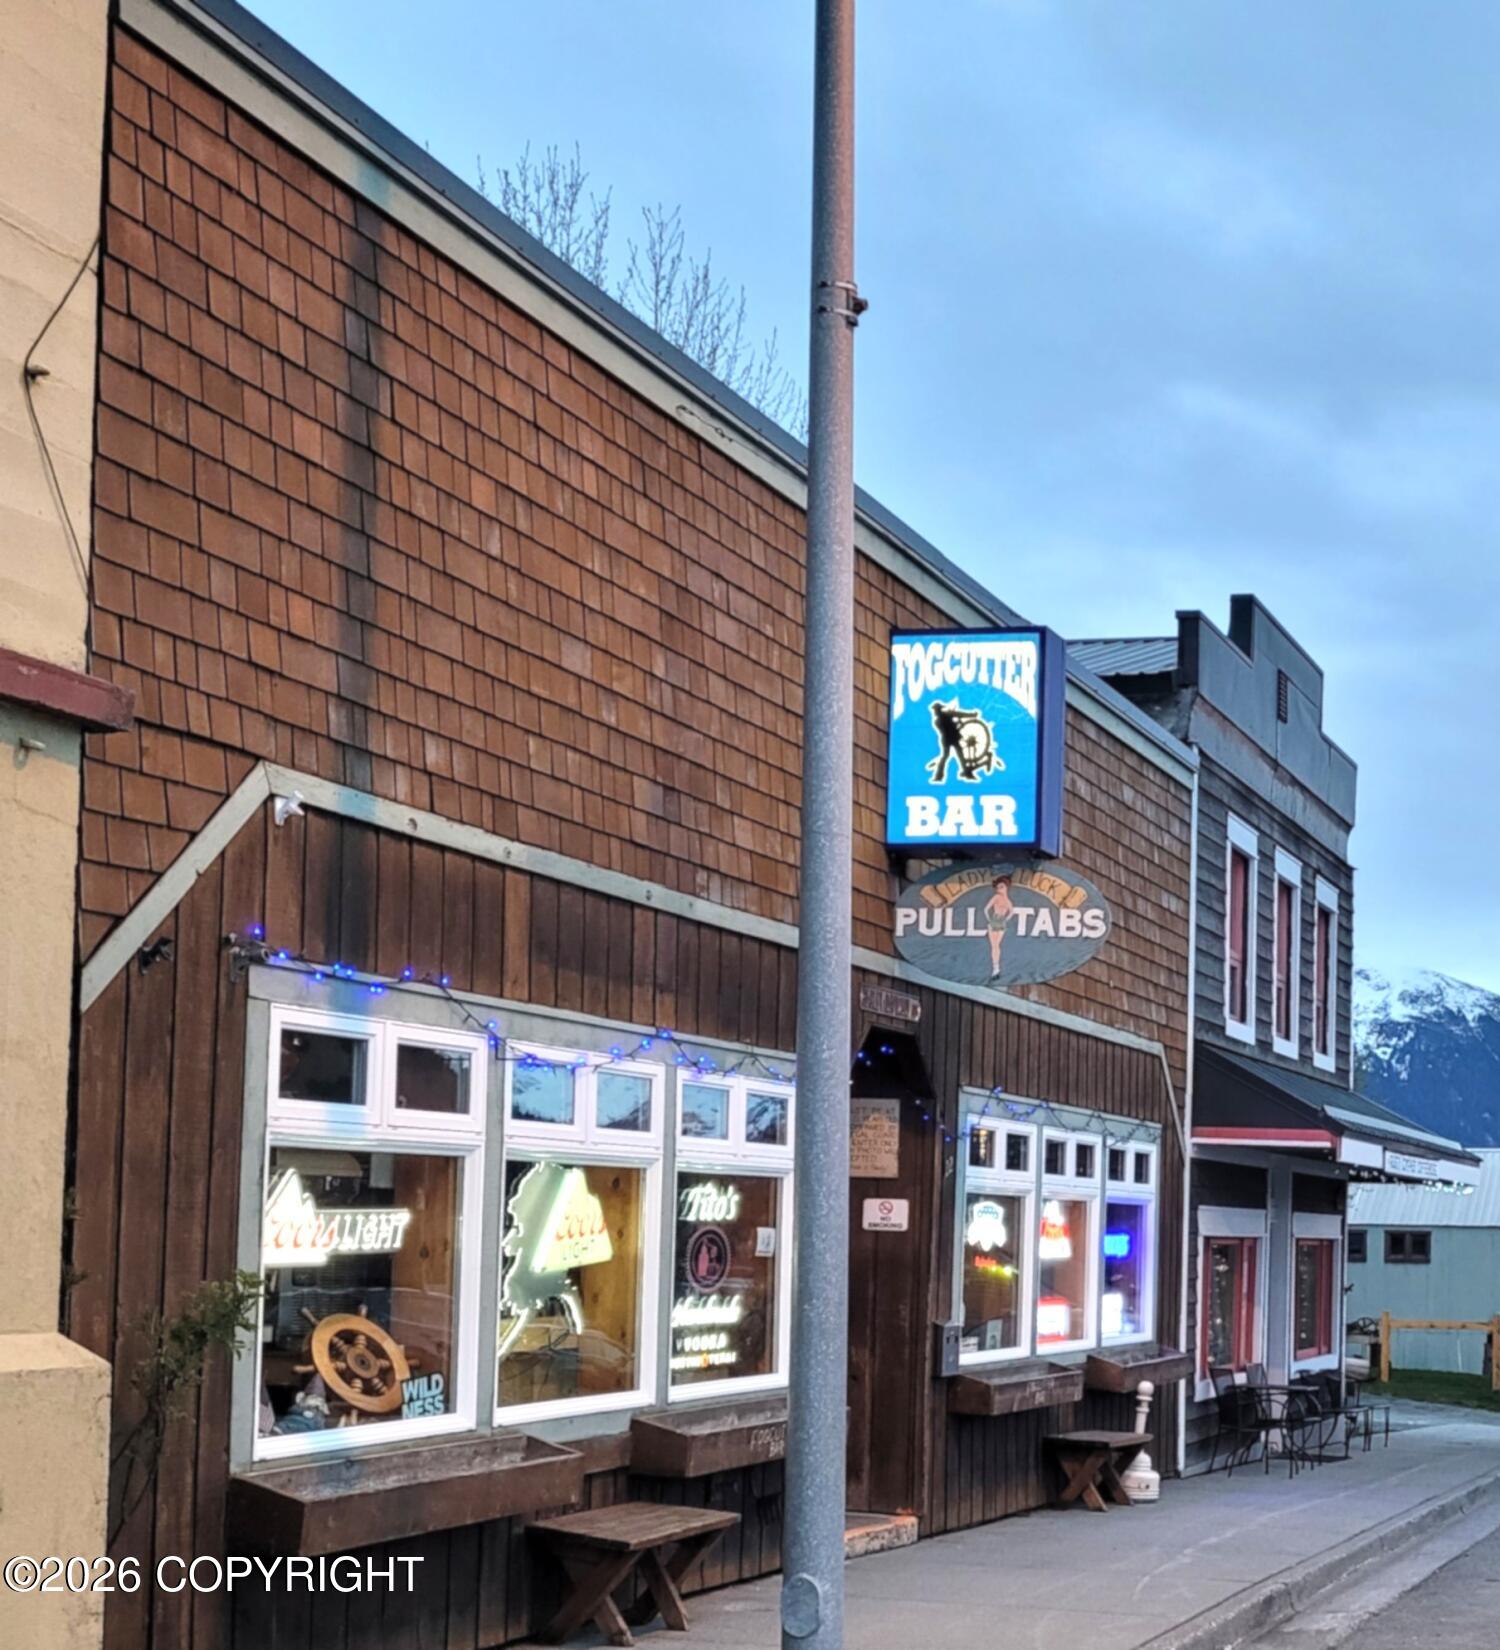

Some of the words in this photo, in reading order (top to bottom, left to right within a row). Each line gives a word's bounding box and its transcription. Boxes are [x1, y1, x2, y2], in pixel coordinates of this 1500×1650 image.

[891, 640, 1037, 720] FOGCUTTER
[905, 795, 1017, 837] BAR
[944, 868, 989, 896] LADY
[1019, 869, 1062, 899] LUCK
[895, 907, 987, 938] PULL
[1012, 907, 1107, 938] TABS
[679, 1182, 740, 1221] Tito's
[337, 1212, 411, 1251] LIGHT
[867, 1221, 904, 1229] SMOKING
[402, 1373, 444, 1402] WILD
[402, 1395, 444, 1419] NESS
